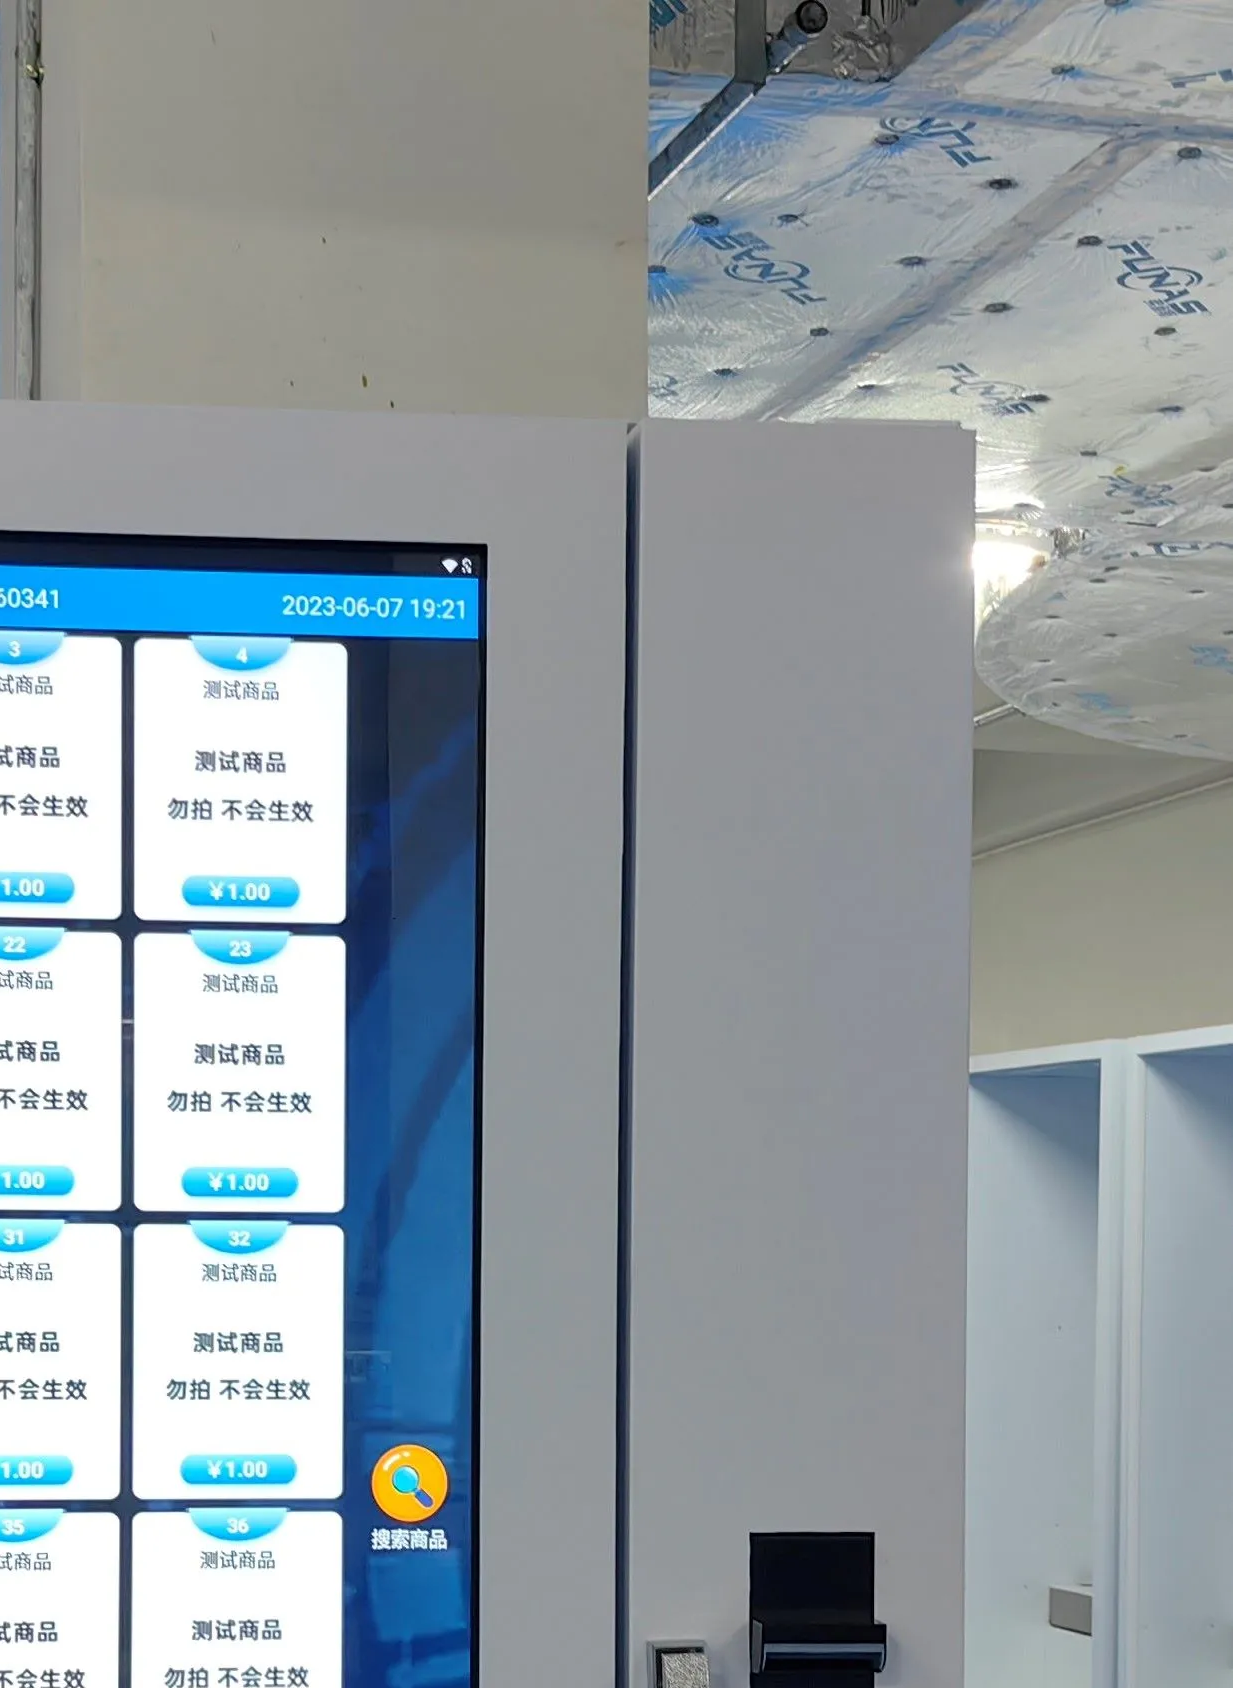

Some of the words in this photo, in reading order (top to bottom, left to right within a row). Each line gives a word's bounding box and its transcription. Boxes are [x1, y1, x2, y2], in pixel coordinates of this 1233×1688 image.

[282, 595, 404, 618] 2023-06-07
[410, 598, 467, 620] 19:21
[8, 641, 21, 658] 3
[236, 647, 248, 664] 4
[203, 679, 280, 701] 测试商品
[195, 751, 285, 773] 测试商品
[168, 798, 212, 820] 勿拍
[222, 800, 313, 821] 不会生效
[3, 937, 25, 953] 22
[228, 941, 252, 958] 23
[202, 973, 279, 994] 测试商品
[195, 1044, 284, 1065] 测试商品
[168, 1091, 211, 1112] 勿拍
[221, 1091, 312, 1113] 不会生效
[3, 1230, 25, 1247] 31
[228, 1231, 250, 1247] 32
[201, 1263, 277, 1283] 测试商品
[194, 1332, 283, 1353] 测试商品
[167, 1379, 210, 1400] 勿拍
[220, 1379, 310, 1400] 不会生效
[2, 1519, 25, 1536] 35
[226, 1517, 249, 1534] 36
[371, 1528, 448, 1550] 搜索商品
[200, 1550, 276, 1570] 测试商品
[192, 1620, 281, 1640] 测试商品
[165, 1668, 208, 1688] 勿拍
[218, 1667, 309, 1688] 不会生效
